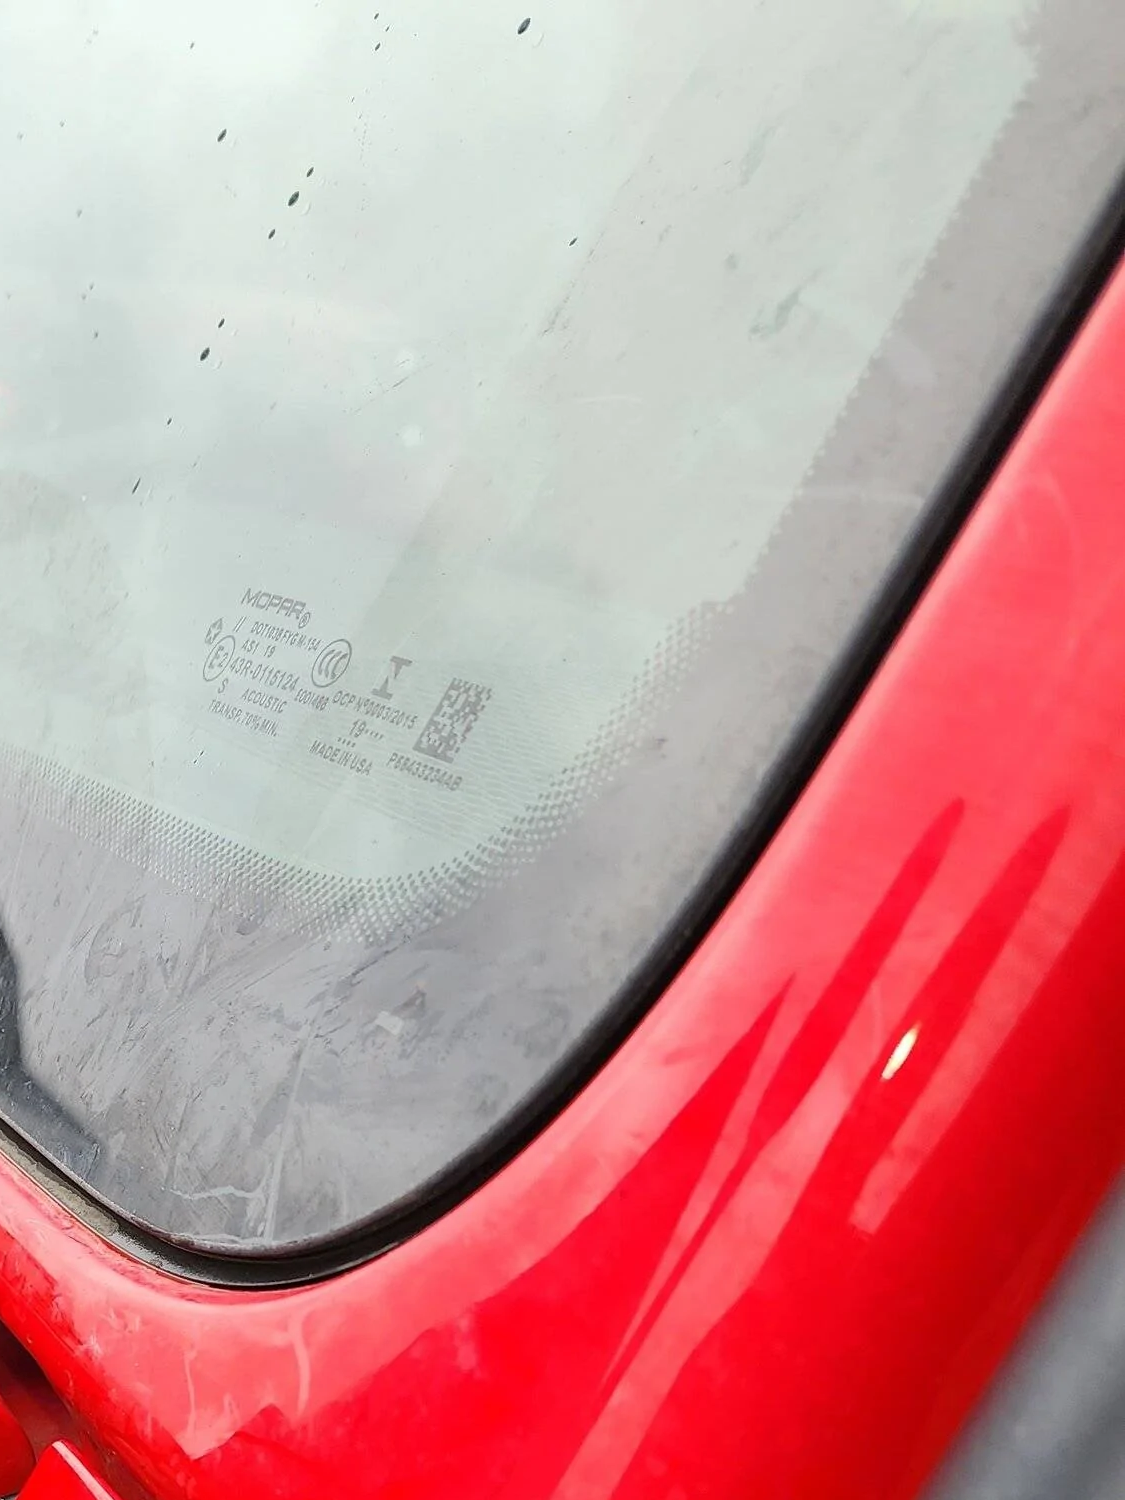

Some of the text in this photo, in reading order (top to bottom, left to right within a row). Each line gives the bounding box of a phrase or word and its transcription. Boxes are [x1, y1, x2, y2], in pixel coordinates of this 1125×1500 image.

[240, 688, 287, 713] ACOUSTIC
[309, 740, 373, 775] MADE IN USA
